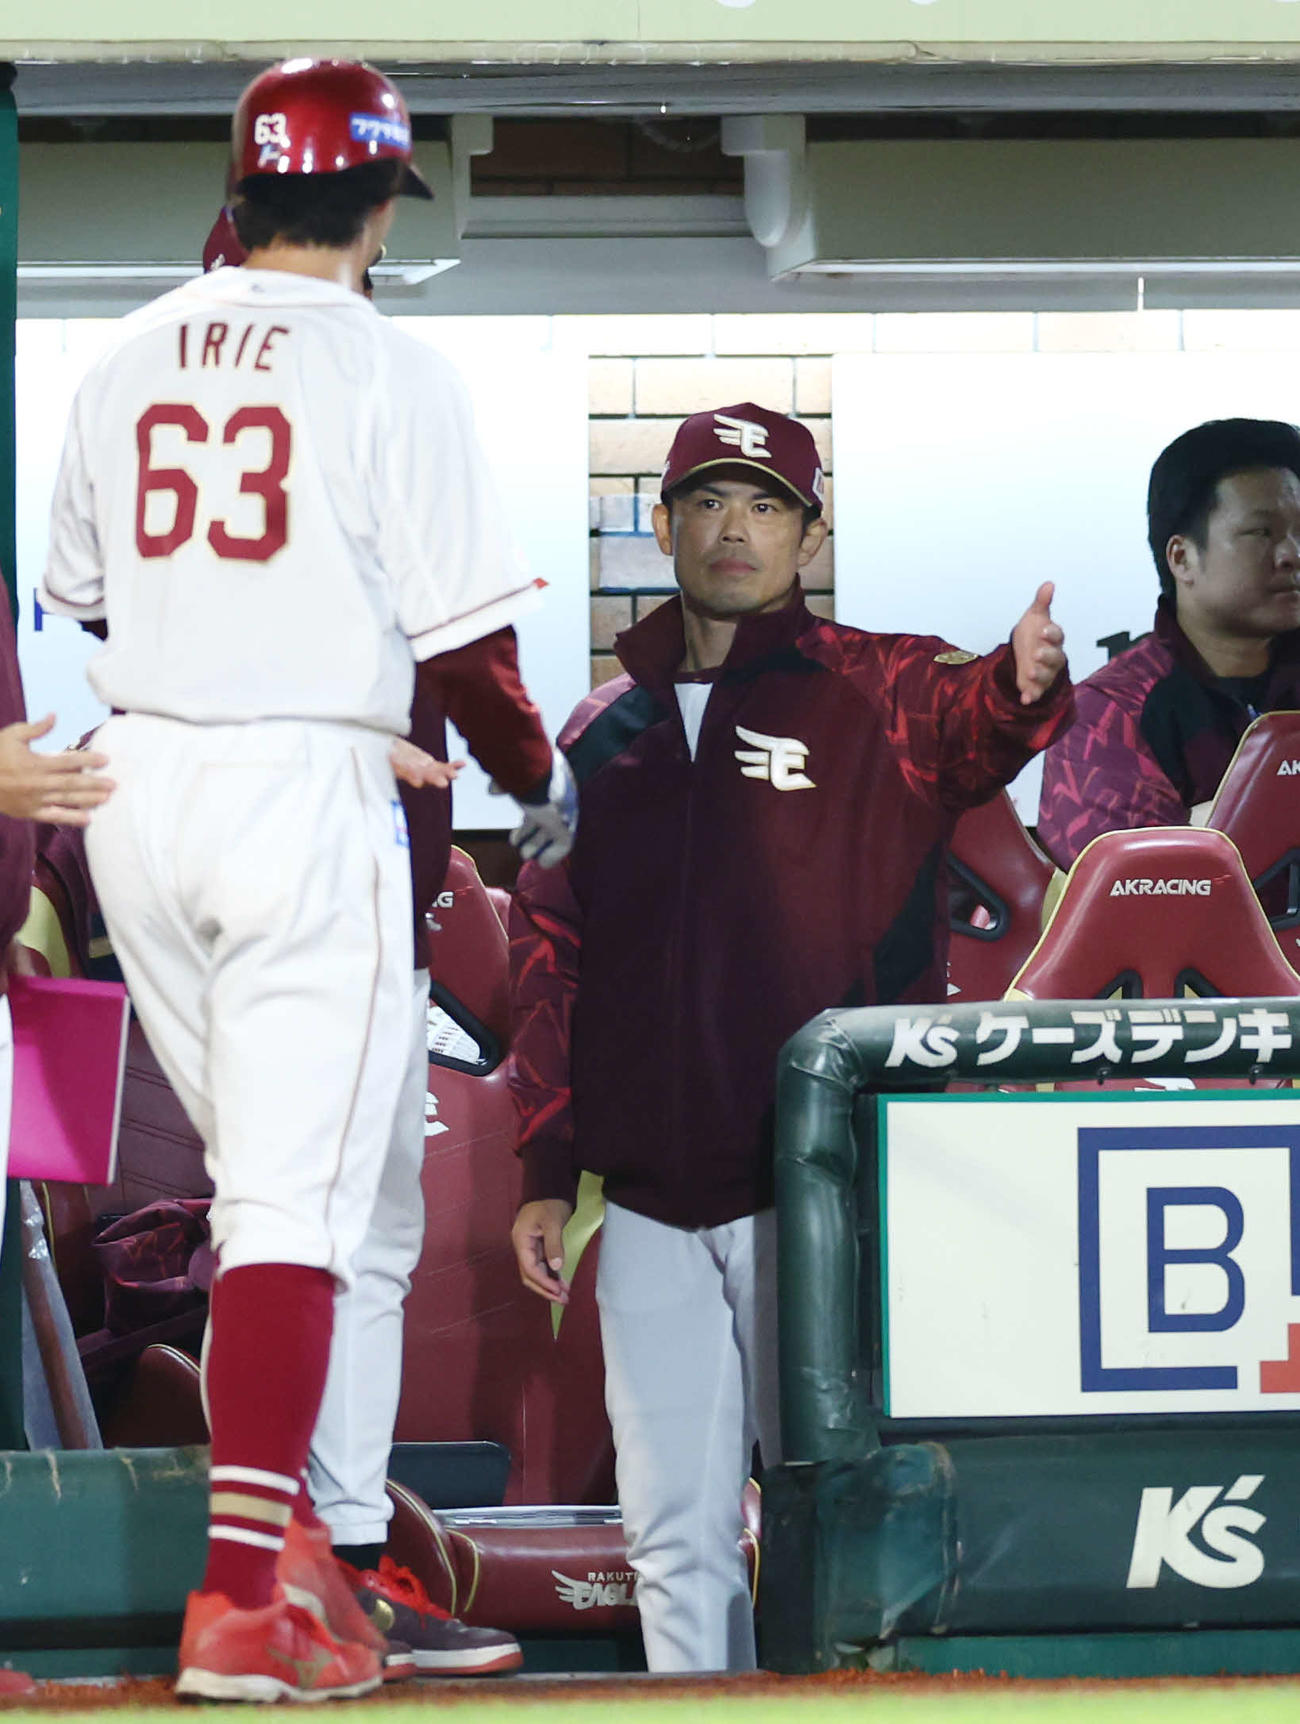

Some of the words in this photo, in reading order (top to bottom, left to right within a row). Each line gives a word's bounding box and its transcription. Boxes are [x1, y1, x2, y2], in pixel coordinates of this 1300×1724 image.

[255, 113, 287, 144] 63
[179, 323, 290, 371] IRIE
[135, 403, 292, 562] 63
[1110, 878, 1211, 896] AKRACING
[976, 1008, 1292, 1065] ケーズデンキ
[1146, 1186, 1246, 1333] B
[551, 1569, 638, 1610] EAGL
